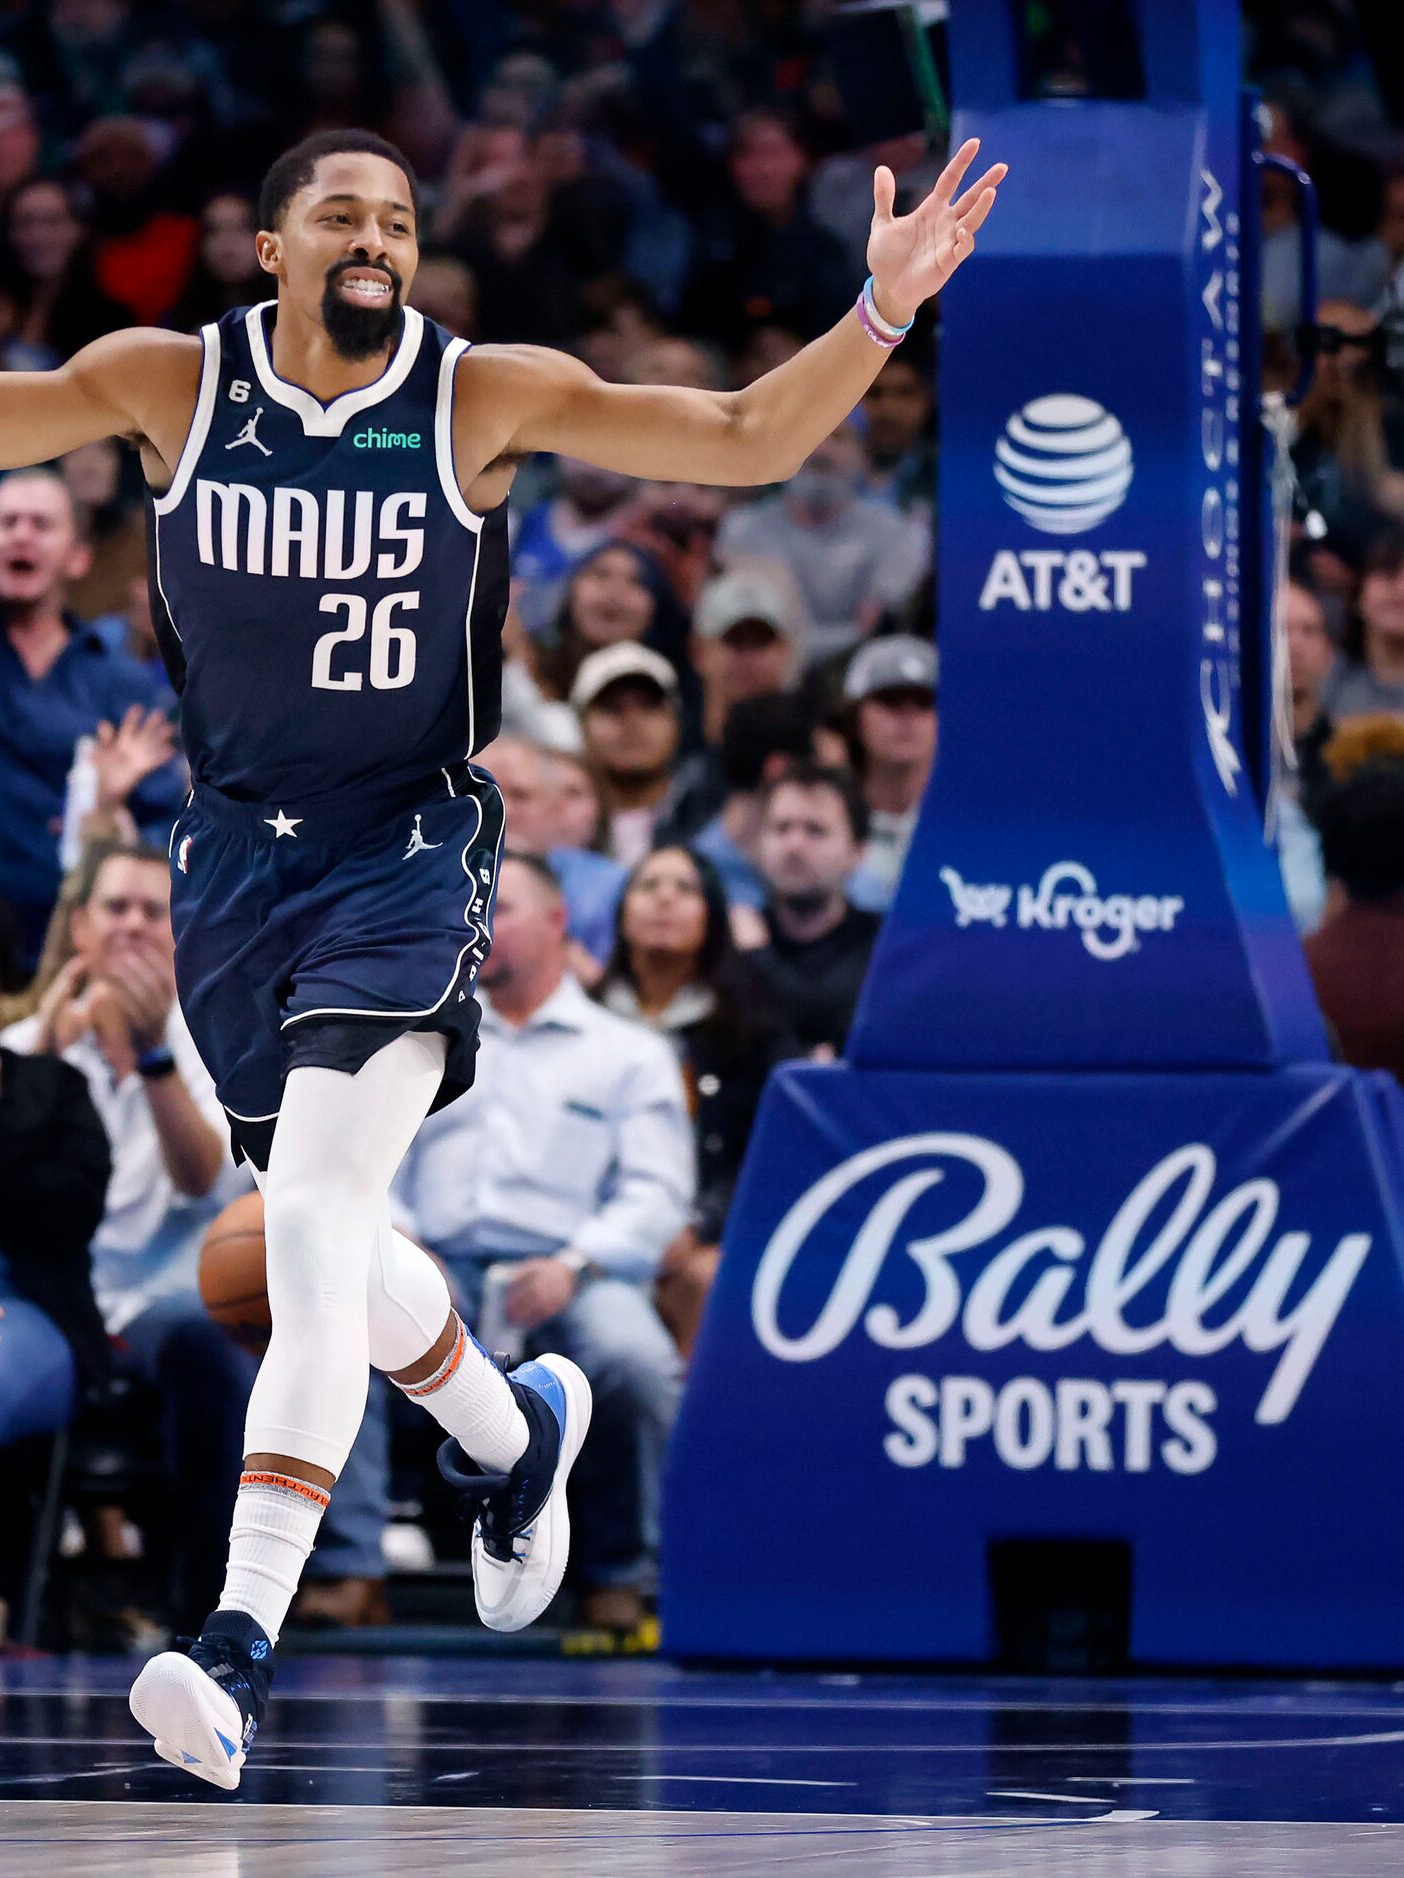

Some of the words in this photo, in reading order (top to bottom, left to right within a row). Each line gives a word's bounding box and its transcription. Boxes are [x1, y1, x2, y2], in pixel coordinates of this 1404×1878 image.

[229, 379, 252, 403] 6
[353, 427, 421, 449] chime
[197, 479, 427, 580] MAVS
[978, 550, 1147, 612] AT&T
[311, 590, 420, 691] 26
[1017, 860, 1185, 961] Kroger
[751, 1132, 1372, 1425] Bally
[883, 1375, 1218, 1475] SPORTS
